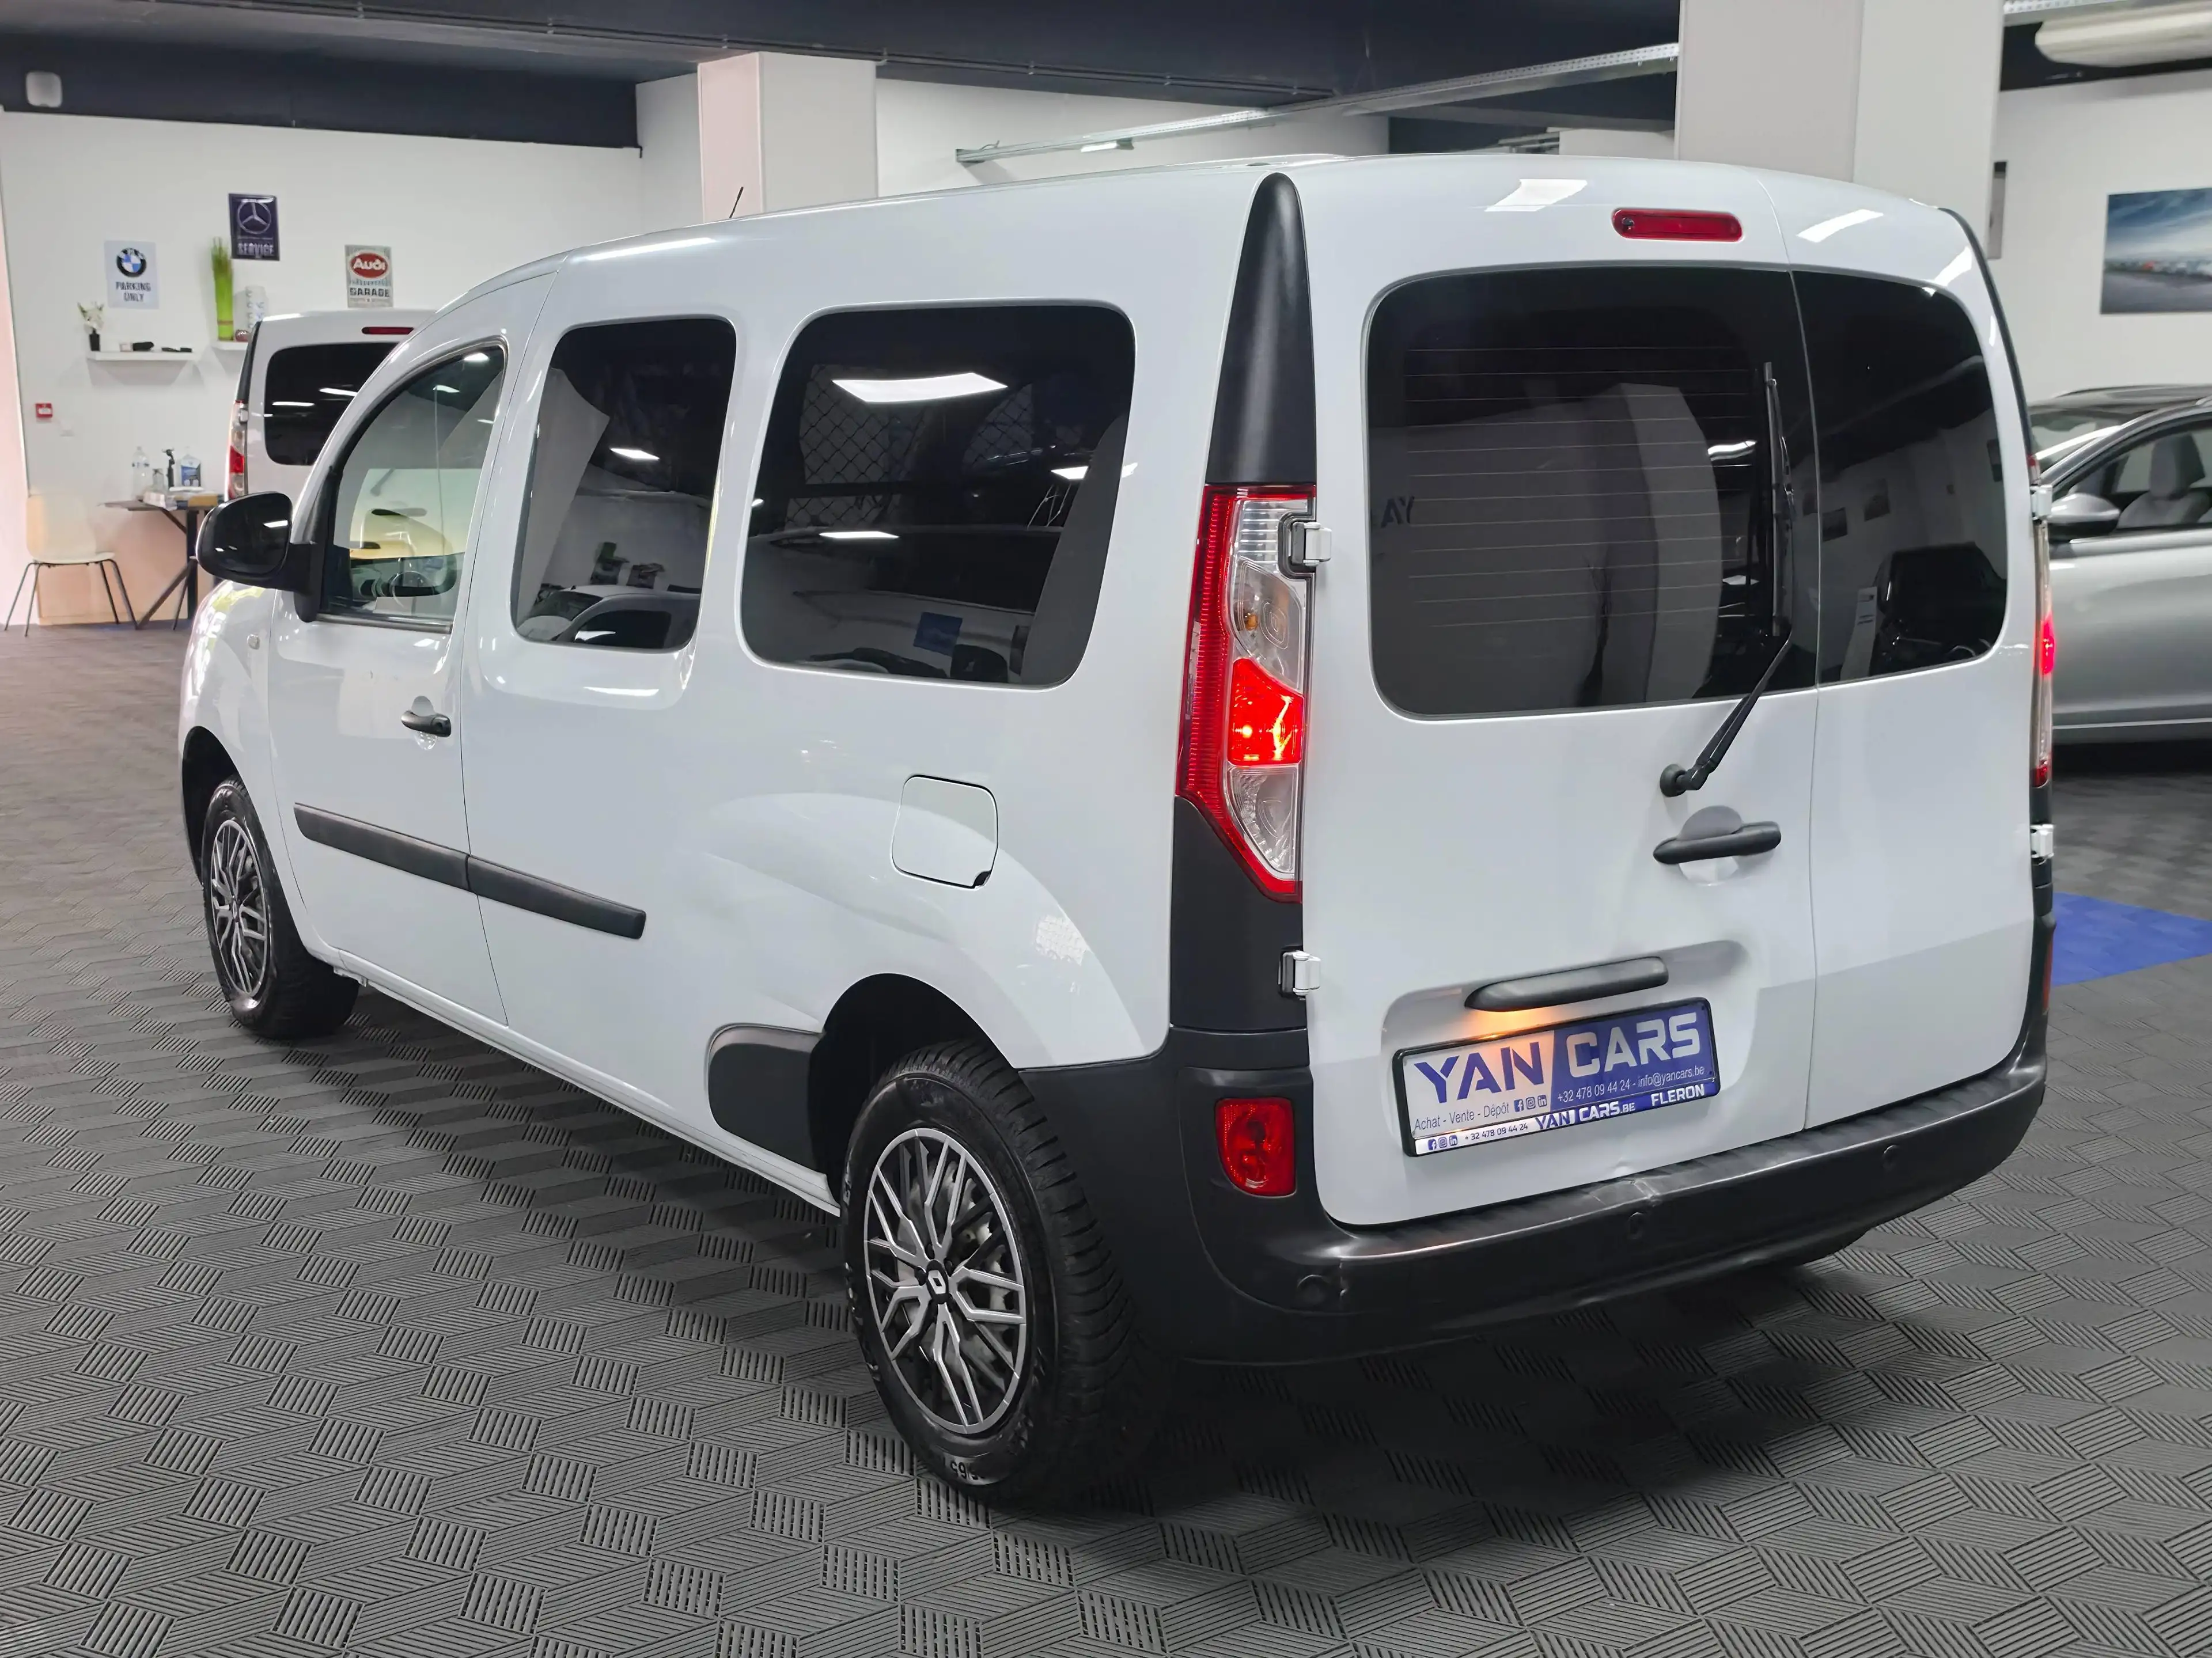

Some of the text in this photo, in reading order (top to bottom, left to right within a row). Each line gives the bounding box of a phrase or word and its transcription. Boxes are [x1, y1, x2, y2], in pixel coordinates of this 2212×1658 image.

[350, 287, 390, 297] GARAGE
[1414, 1012, 1701, 1103] YAN CARS
[1557, 1090, 1574, 1103] +32
[1576, 1086, 1592, 1101] 478
[1594, 1084, 1605, 1097] 09
[1607, 1080, 1618, 1093] 44
[1620, 1078, 1631, 1092] 24
[1638, 1065, 1705, 1086] info@yancars.be
[1449, 1111, 1475, 1124] Vente
[1483, 1101, 1509, 1119] Dépôt
[1470, 1132, 1480, 1141] 32
[1482, 1129, 1495, 1139] 478
[1497, 1127, 1506, 1136] 09
[1508, 1125, 1518, 1134] 44
[1519, 1122, 1528, 1131] 24
[1535, 1112, 1571, 1129] YAN
[1651, 1084, 1705, 1106] FLERON
